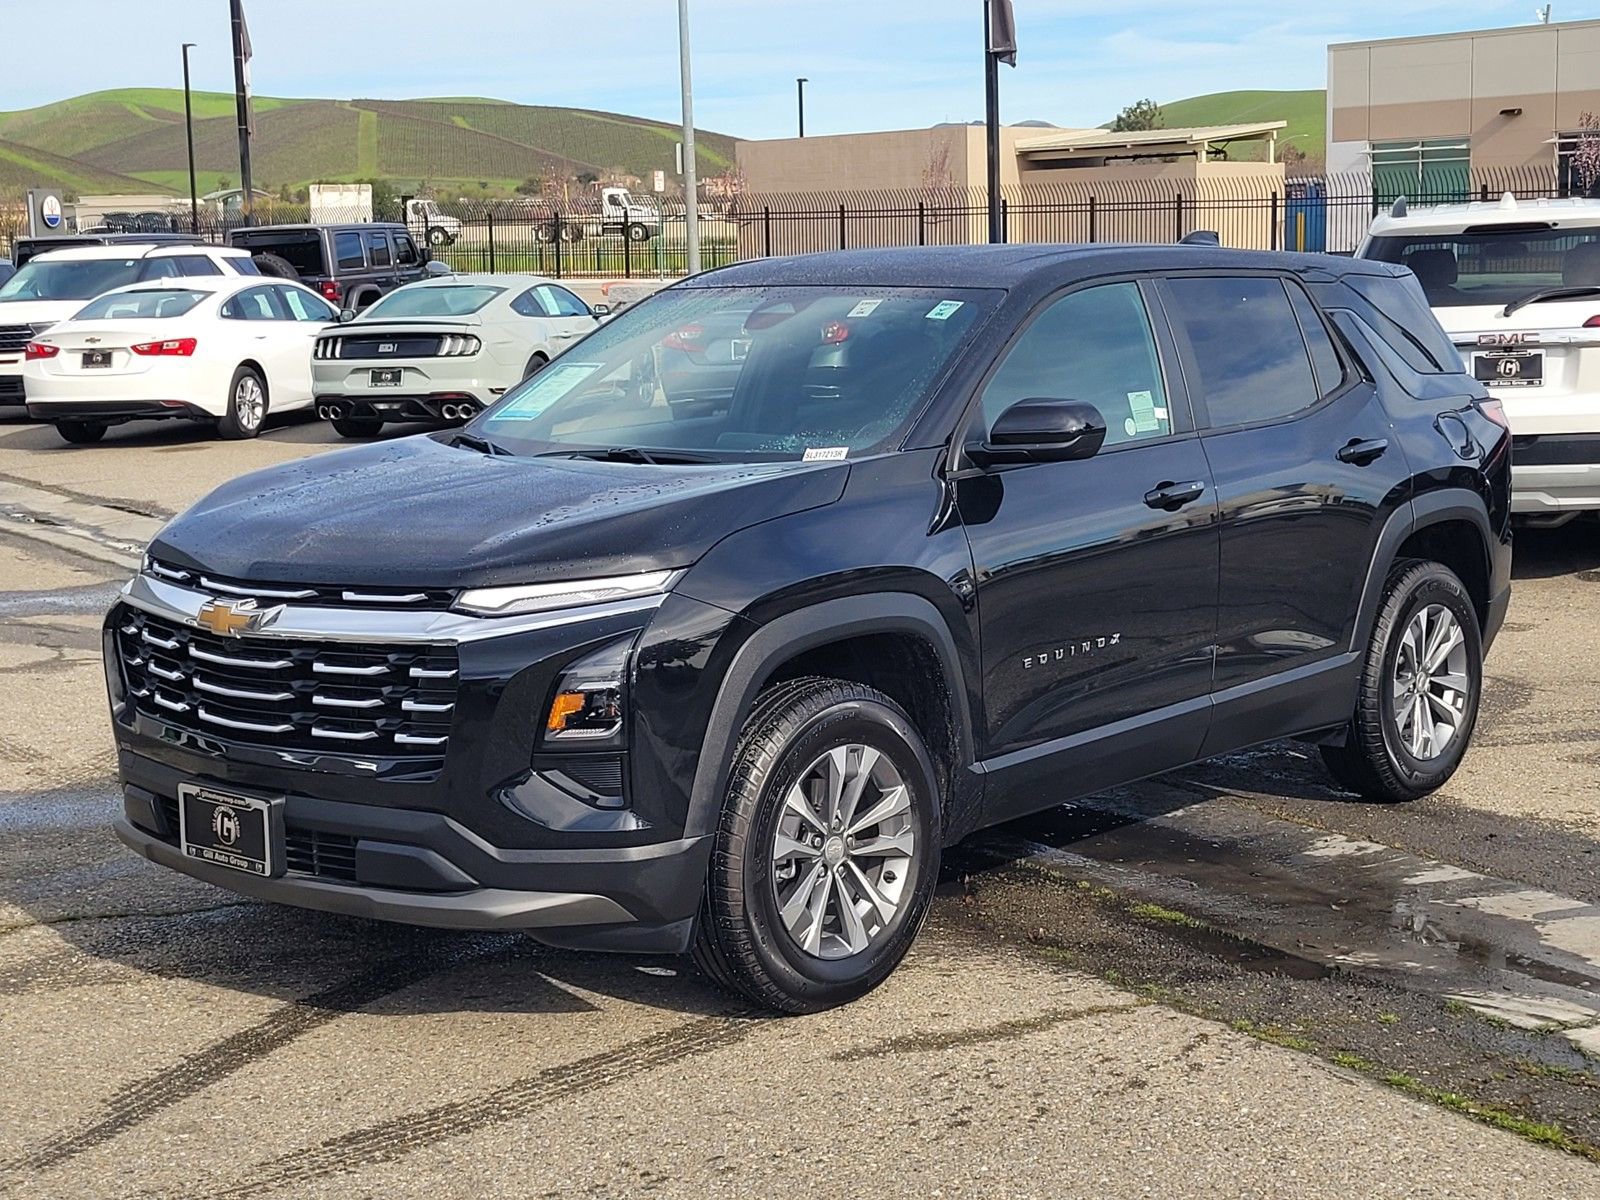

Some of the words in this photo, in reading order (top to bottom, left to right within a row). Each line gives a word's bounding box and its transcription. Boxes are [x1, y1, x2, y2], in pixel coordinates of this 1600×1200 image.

[1478, 333, 1540, 346] GMC
[1022, 632, 1121, 669] EQUINOX
[203, 850, 214, 860] Gill
[214, 852, 229, 863] Auto
[229, 856, 248, 868] Group
